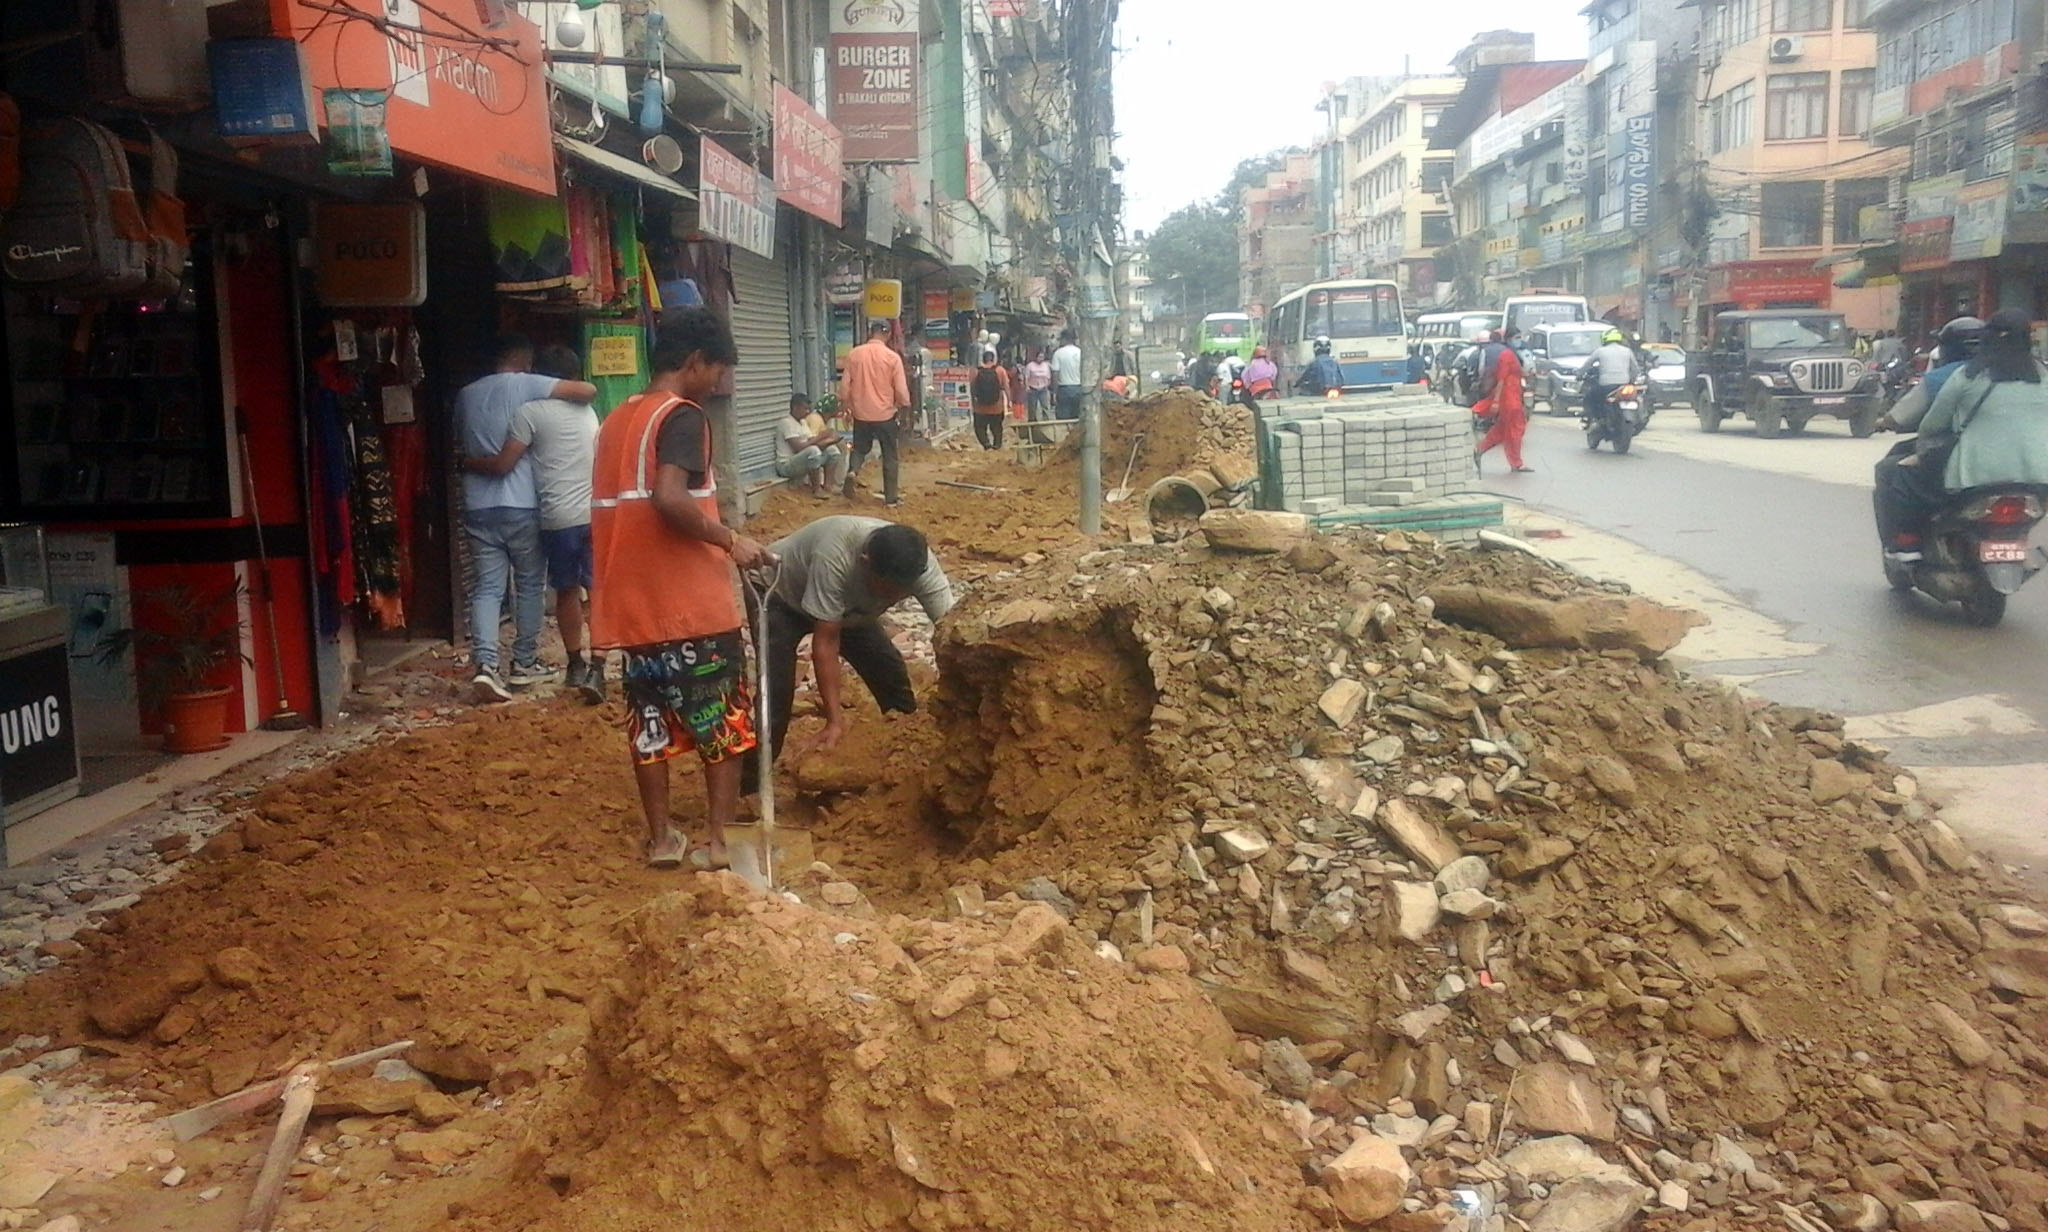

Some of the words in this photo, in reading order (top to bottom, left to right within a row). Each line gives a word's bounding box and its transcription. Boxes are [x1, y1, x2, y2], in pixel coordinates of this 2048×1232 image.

[838, 46, 911, 67] BURGER
[862, 69, 911, 89] ZONE
[845, 92, 877, 105] THAKALI
[878, 92, 911, 105] KITCHEN
[870, 294, 894, 303] POCO
[0, 695, 60, 754] UNG
